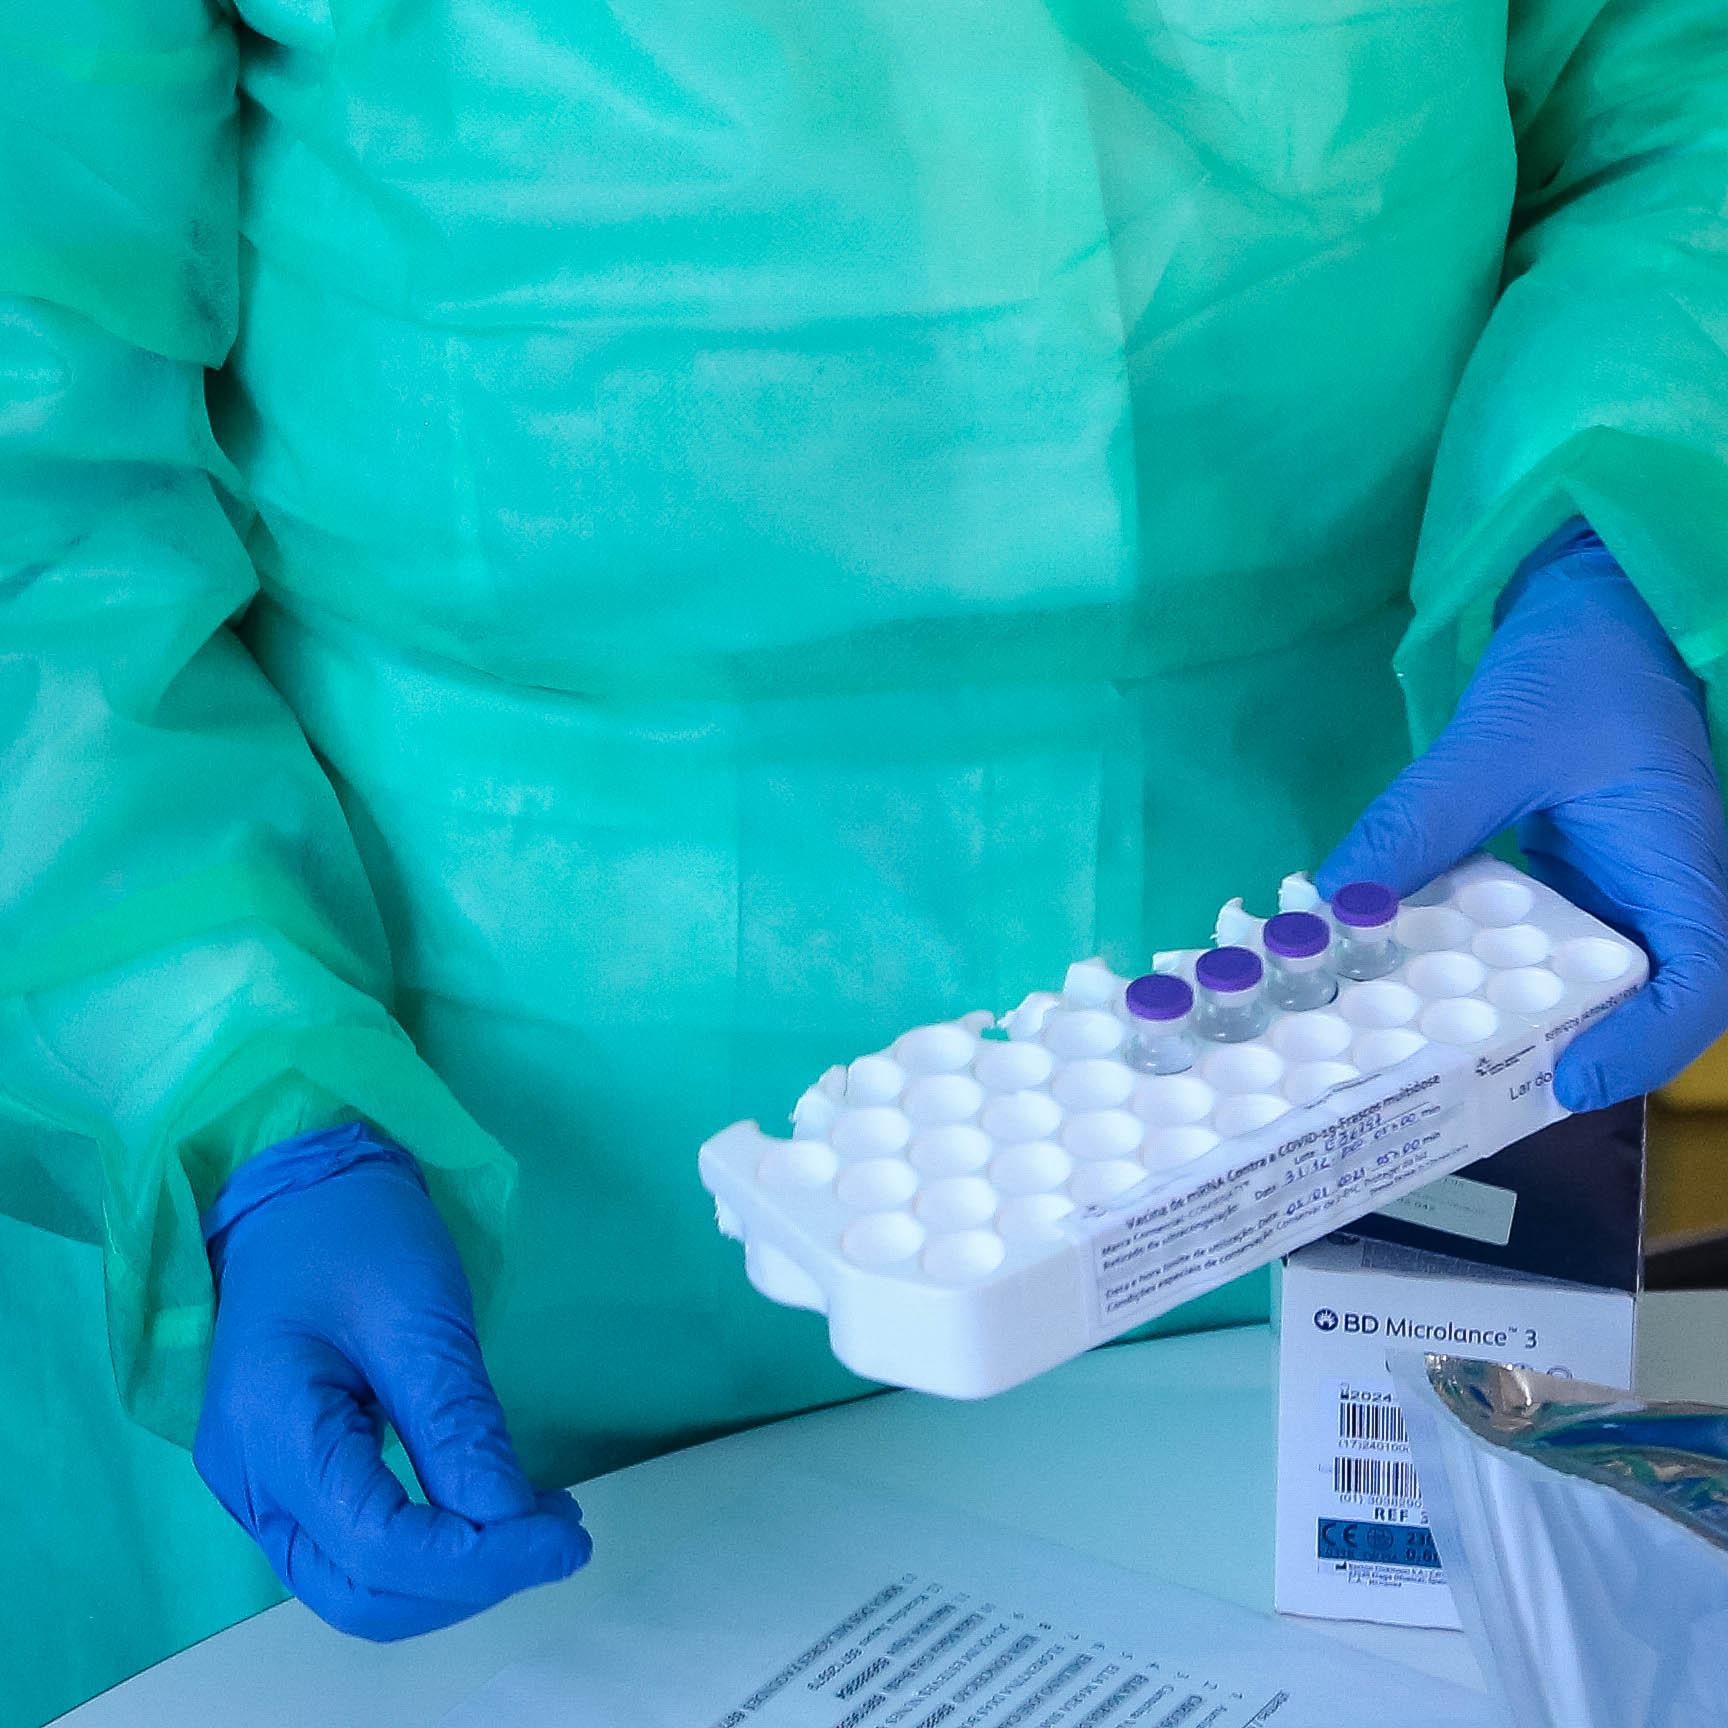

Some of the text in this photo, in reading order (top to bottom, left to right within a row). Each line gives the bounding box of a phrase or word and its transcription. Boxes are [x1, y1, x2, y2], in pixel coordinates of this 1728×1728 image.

[1509, 1079, 1532, 1102] Lar
[1402, 1138, 1421, 1155] 00
[1343, 1313, 1379, 1335] BD
[1524, 1329, 1538, 1349] 3
[1374, 1506, 1410, 1523] REF
